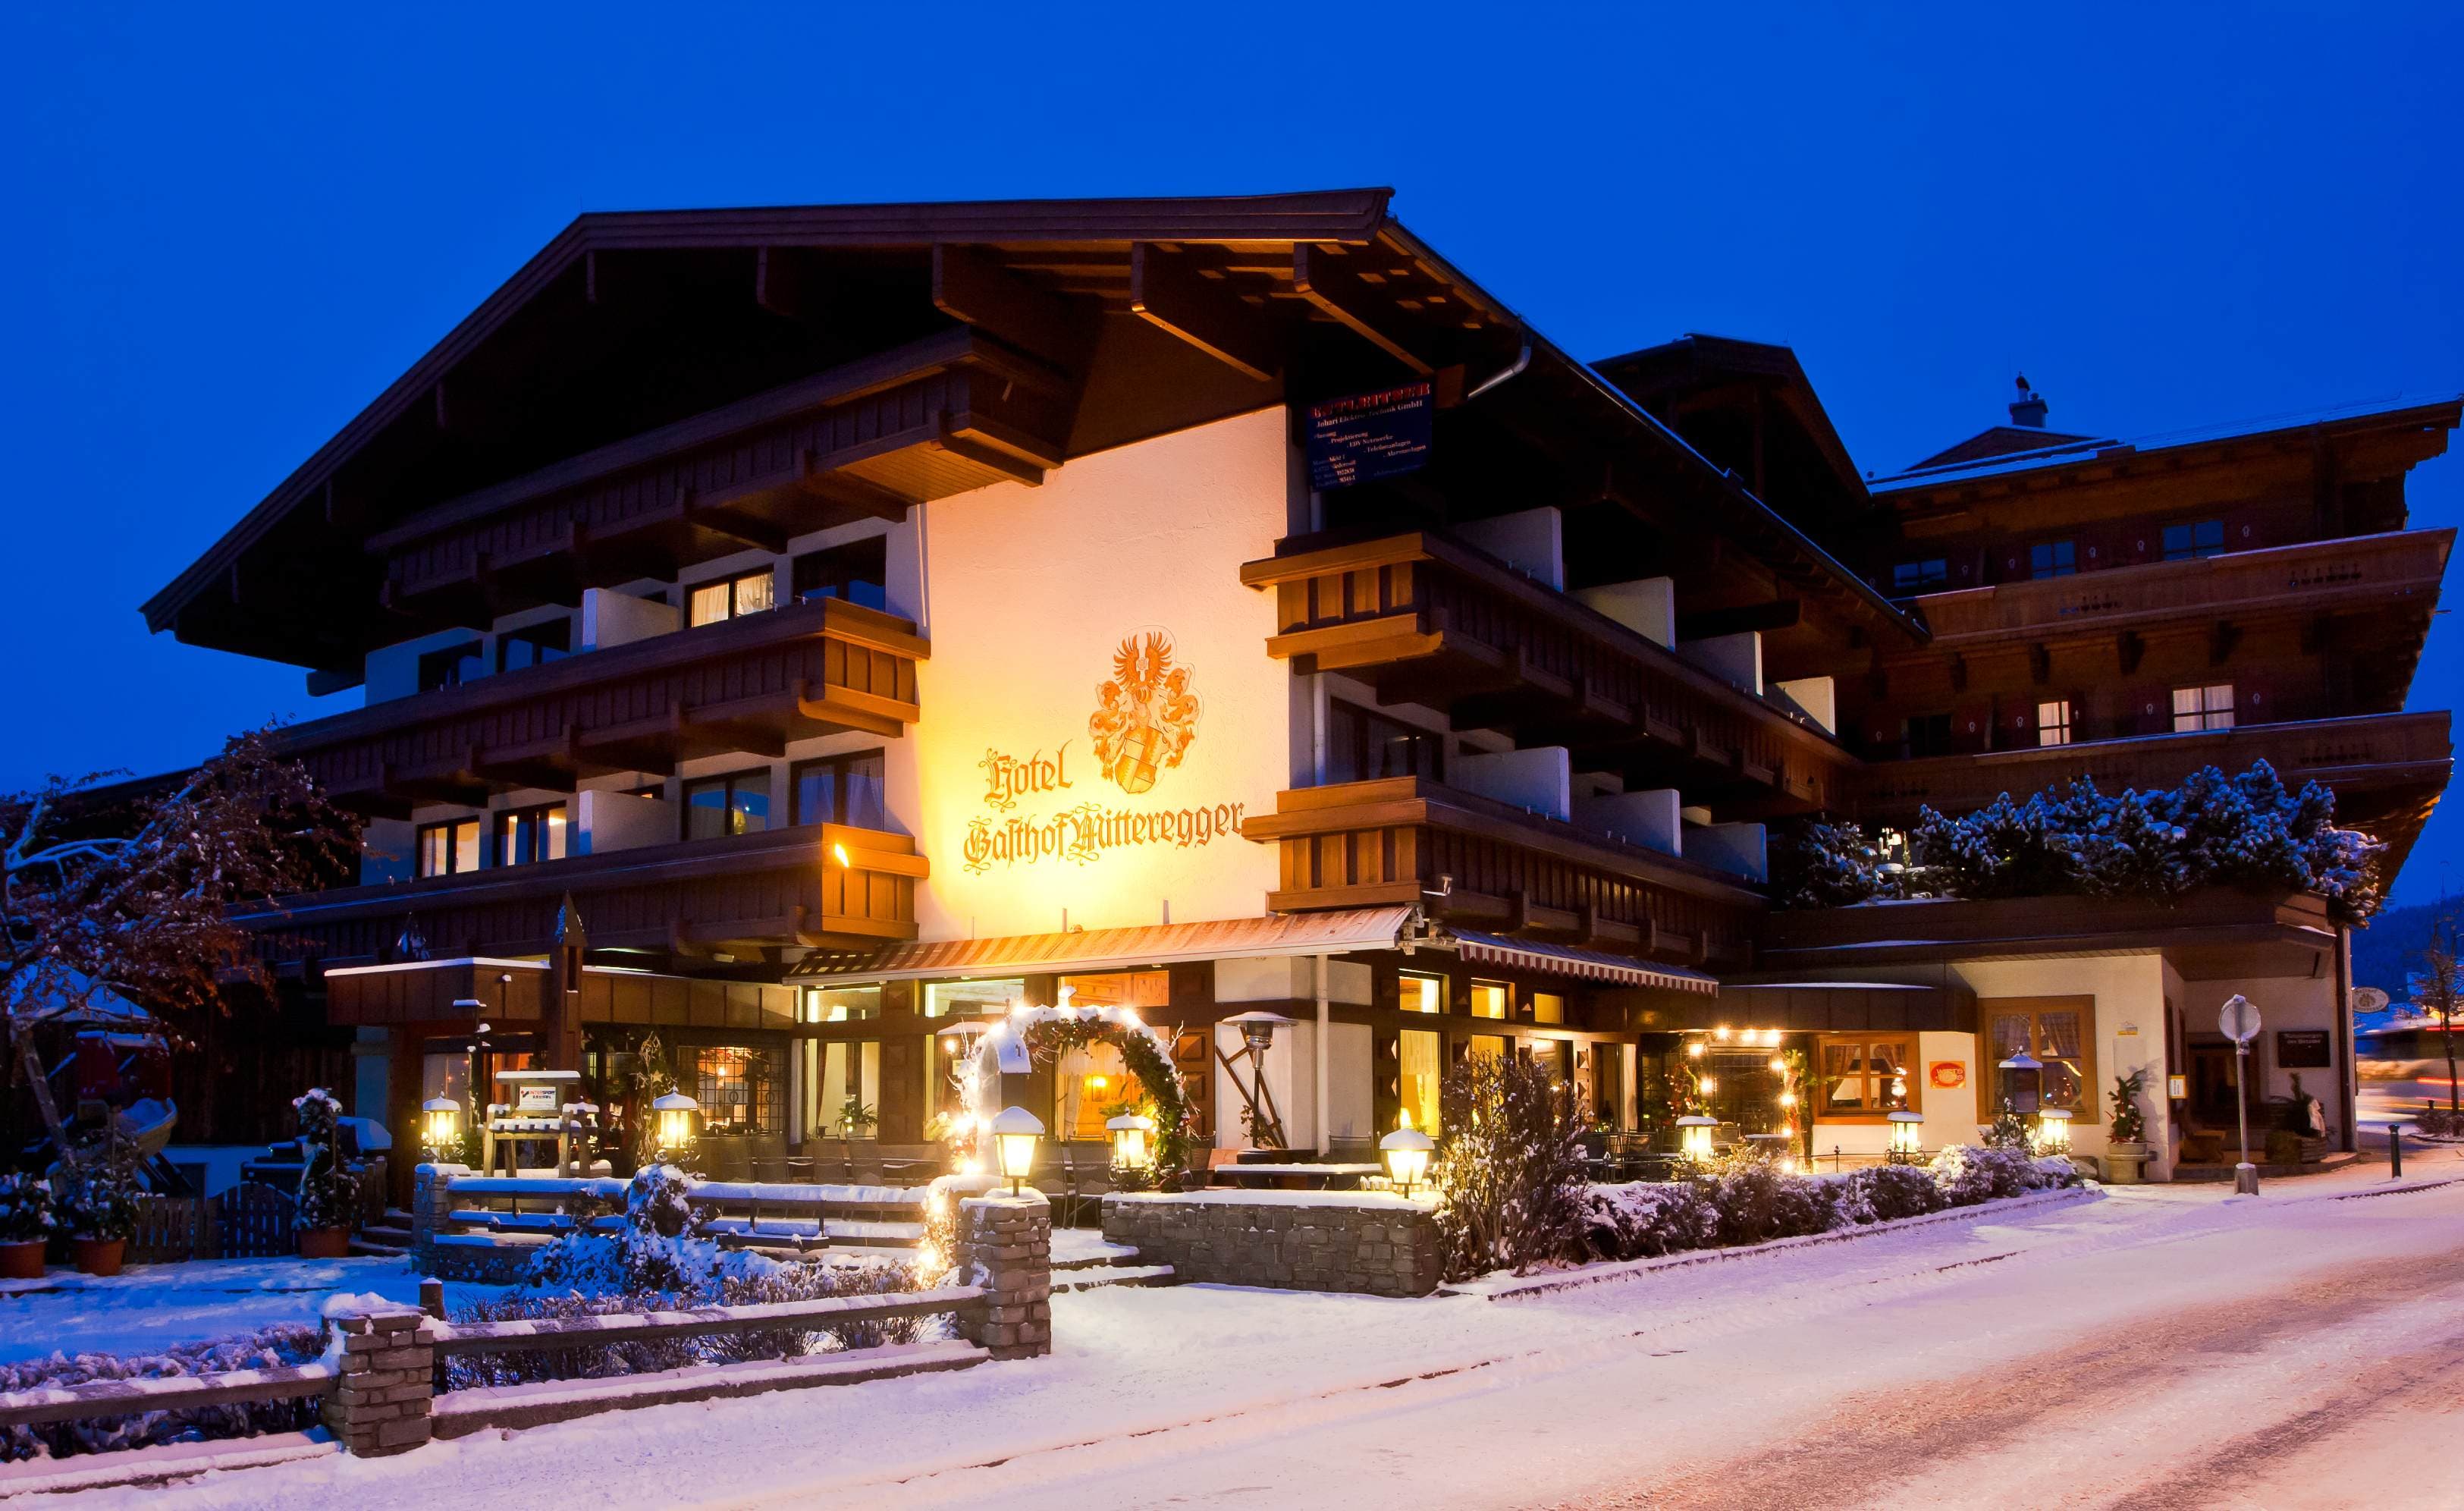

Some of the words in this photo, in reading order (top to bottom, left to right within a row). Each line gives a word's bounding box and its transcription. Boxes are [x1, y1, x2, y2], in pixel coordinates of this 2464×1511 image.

[1398, 400, 1423, 411] GmbH
[978, 739, 1074, 813] Hotel
[1067, 802, 1245, 866] Mitteregger
